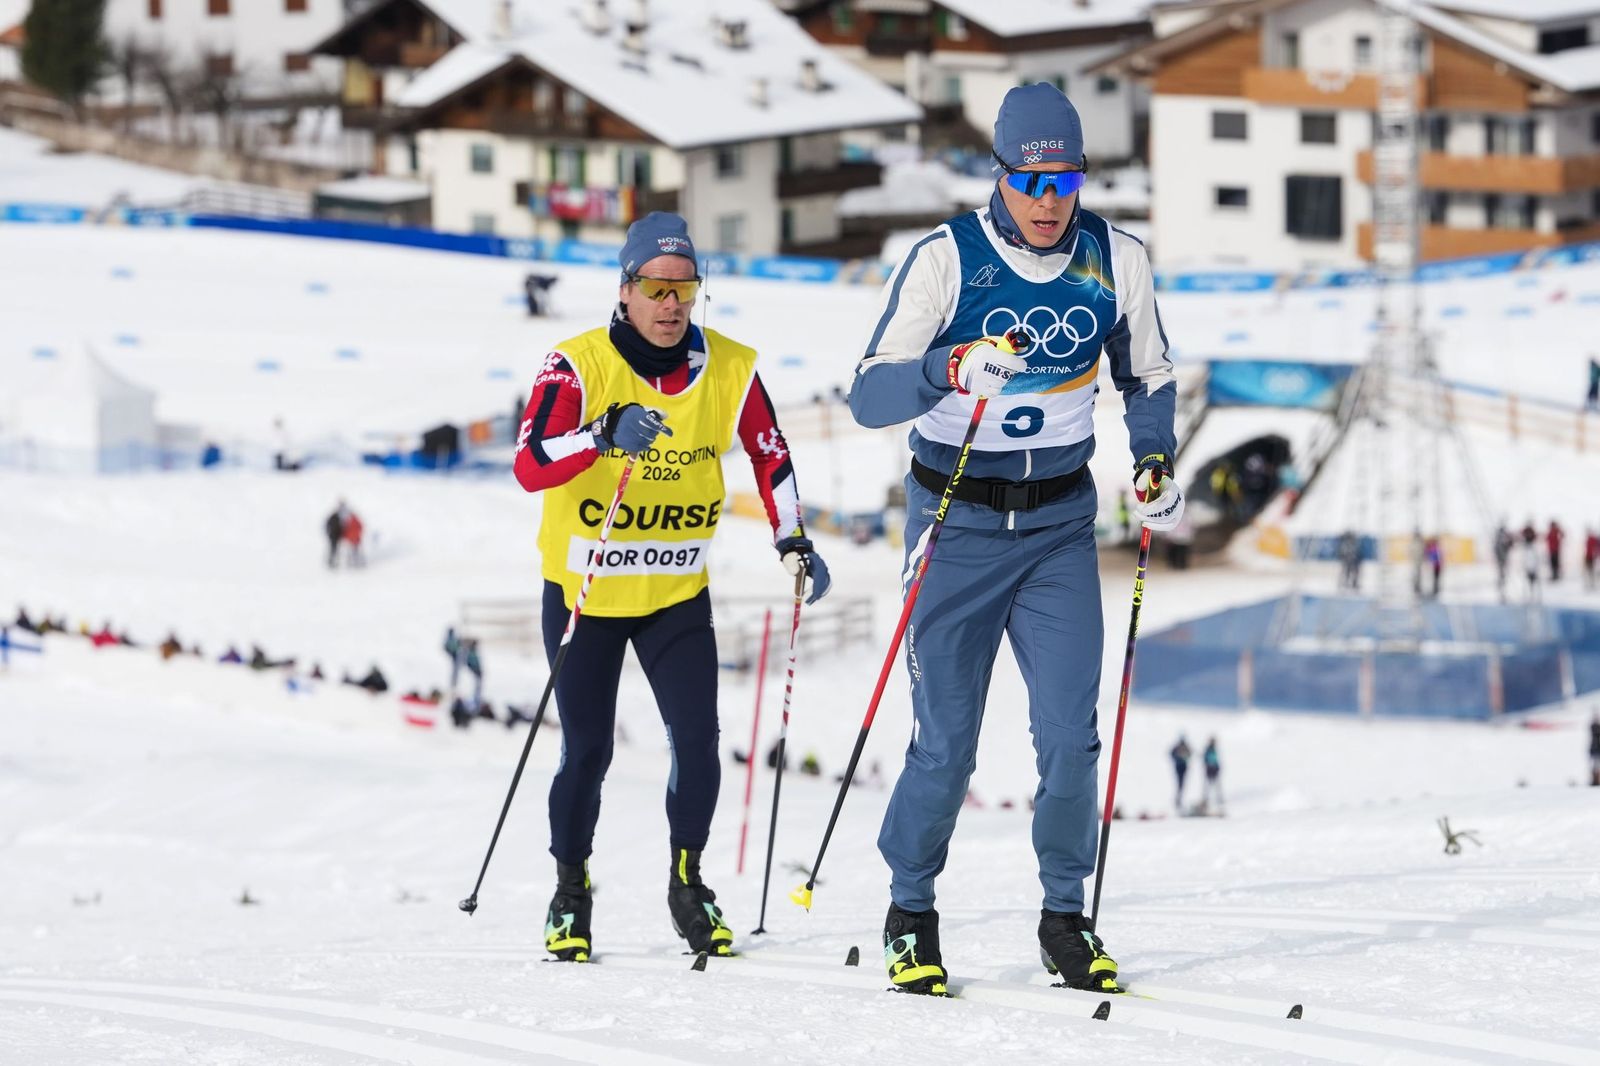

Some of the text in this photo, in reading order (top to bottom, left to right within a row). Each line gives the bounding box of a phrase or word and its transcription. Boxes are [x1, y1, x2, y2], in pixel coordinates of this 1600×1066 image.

[1021, 140, 1064, 152] NORGE
[1024, 366, 1072, 374] CORTINA
[535, 373, 573, 387] CRAFT
[642, 465, 681, 481] 2026
[579, 498, 721, 531] COURSE
[587, 547, 700, 567] NOR 0097
[1132, 565, 1146, 606] LEKI
[909, 624, 919, 669] CRAFT
